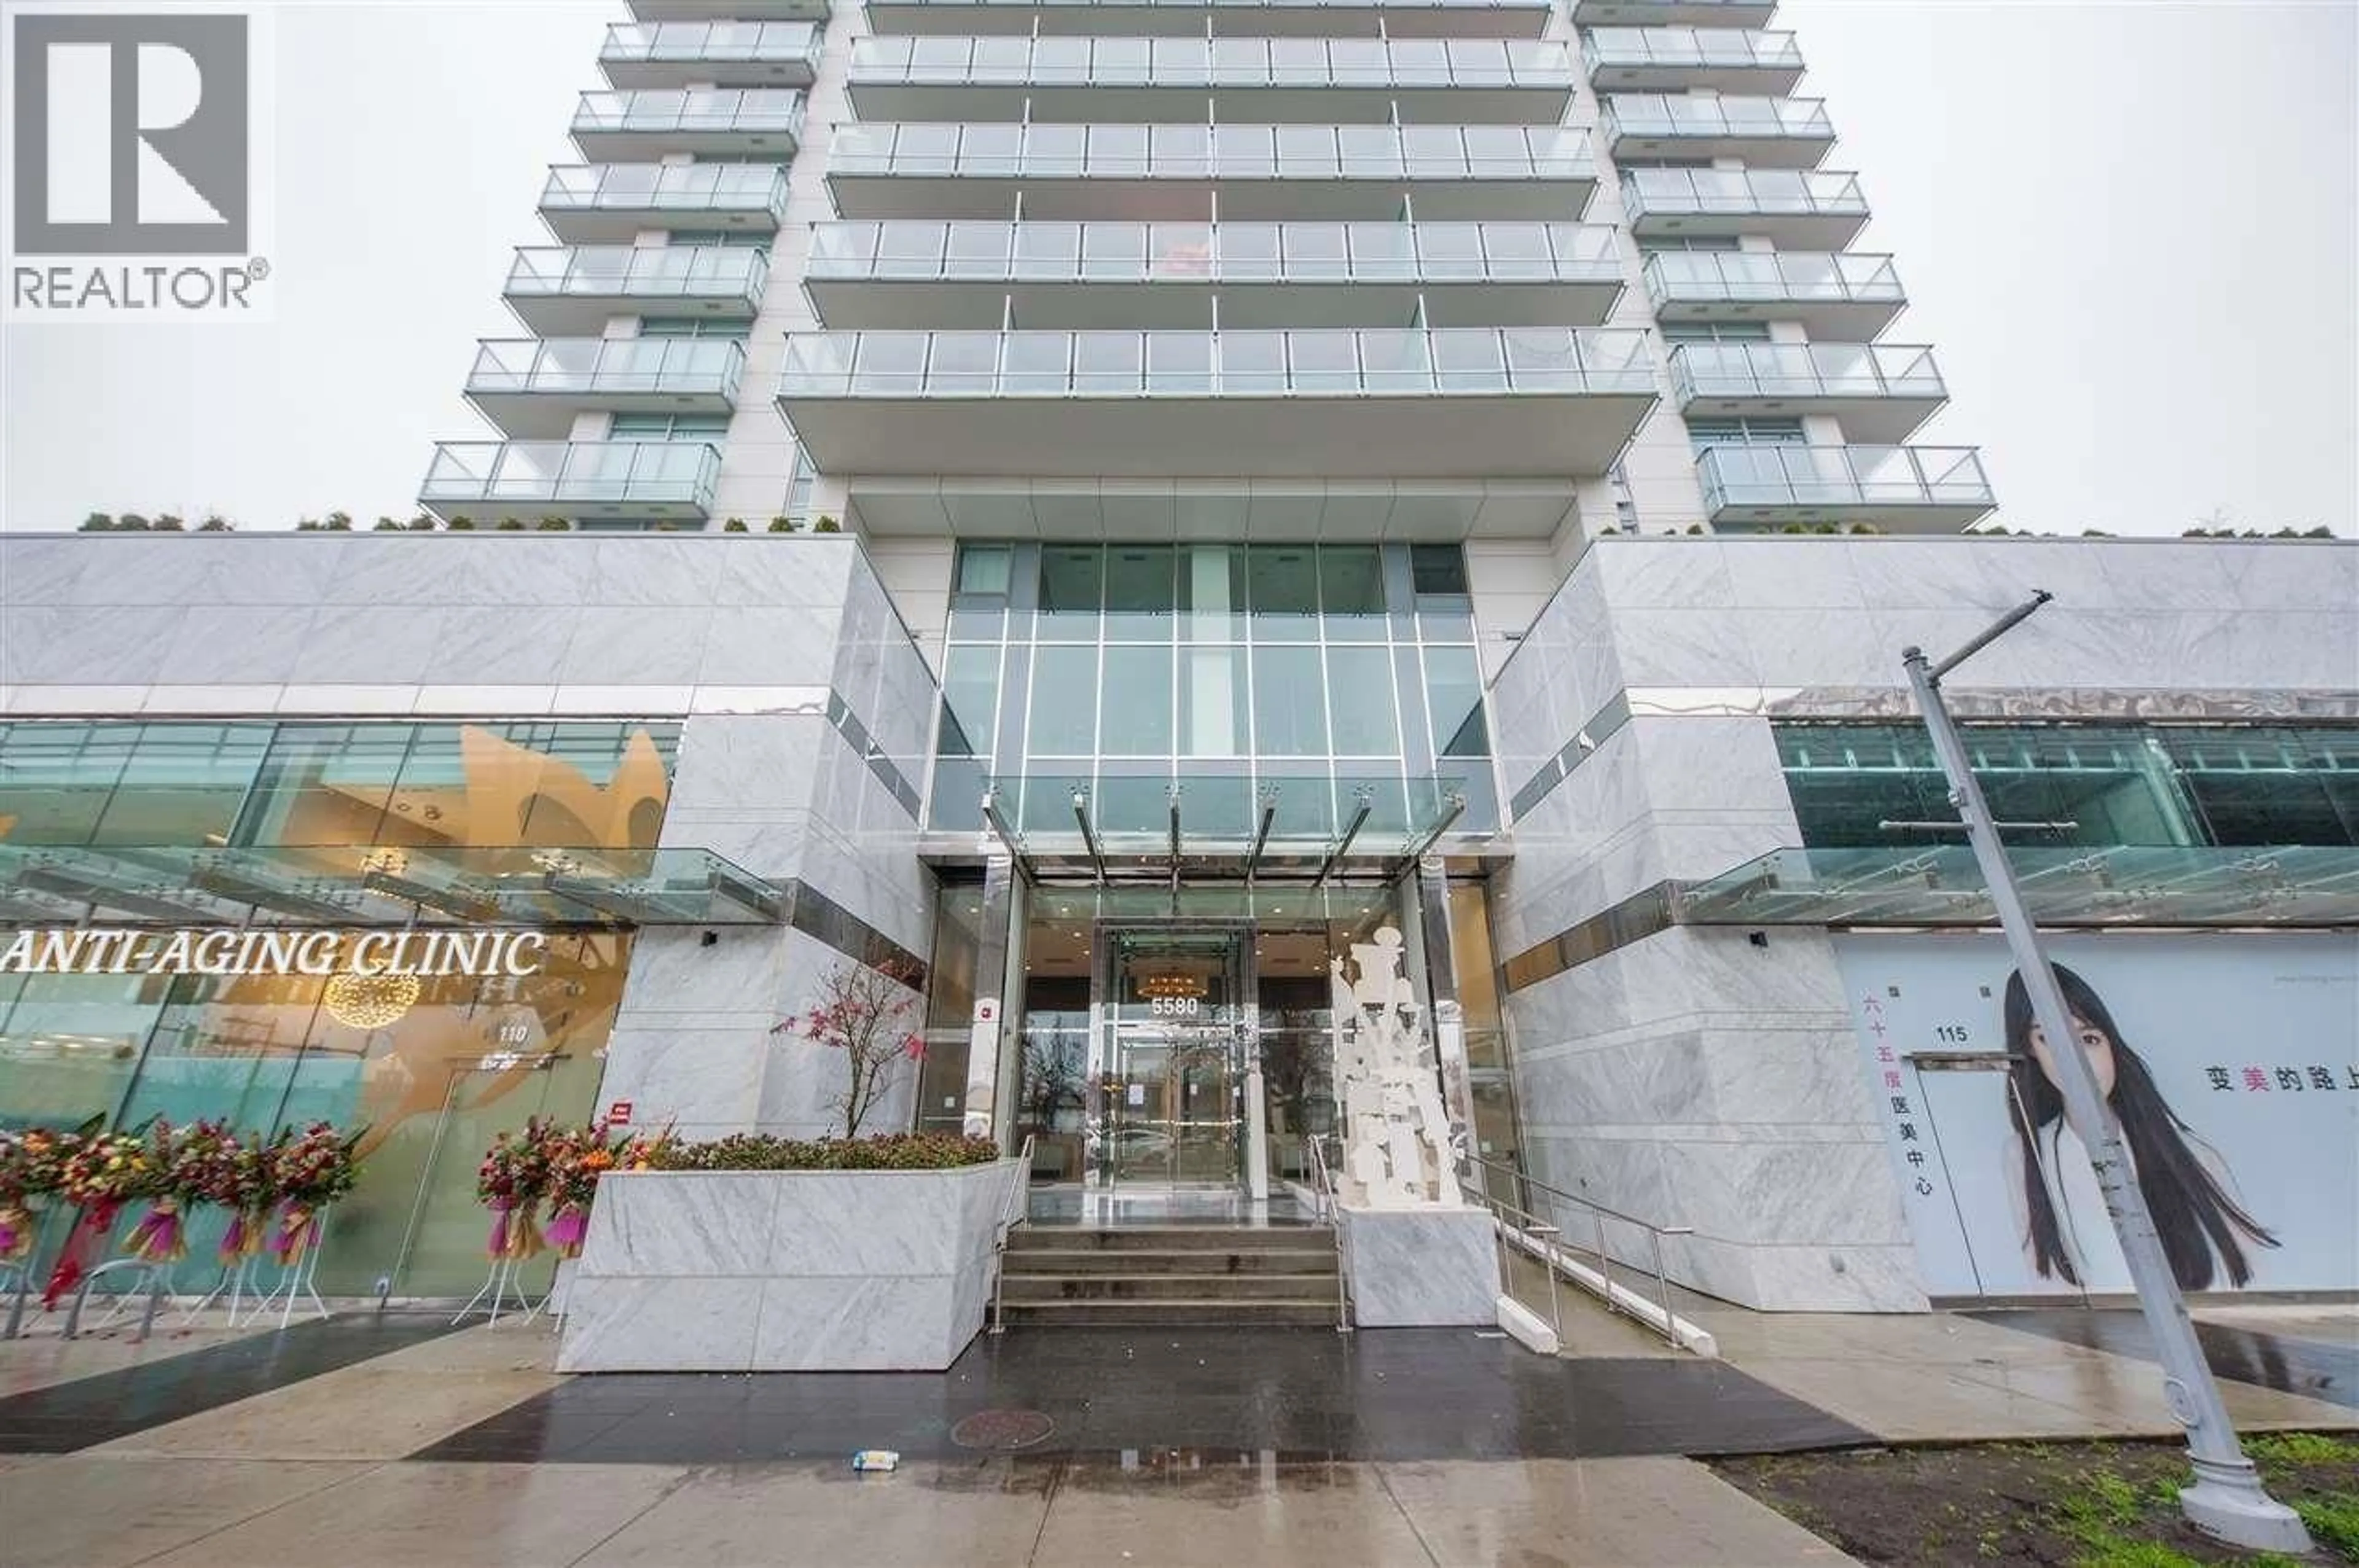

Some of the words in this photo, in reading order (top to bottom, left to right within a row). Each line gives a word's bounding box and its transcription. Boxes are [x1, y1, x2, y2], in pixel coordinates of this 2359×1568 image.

[0, 929, 339, 974] ANTI-AGING
[352, 930, 546, 975] CLINIC
[1151, 997, 1197, 1015] 5580
[501, 1026, 528, 1042] 110
[1936, 1026, 1968, 1042] 115
